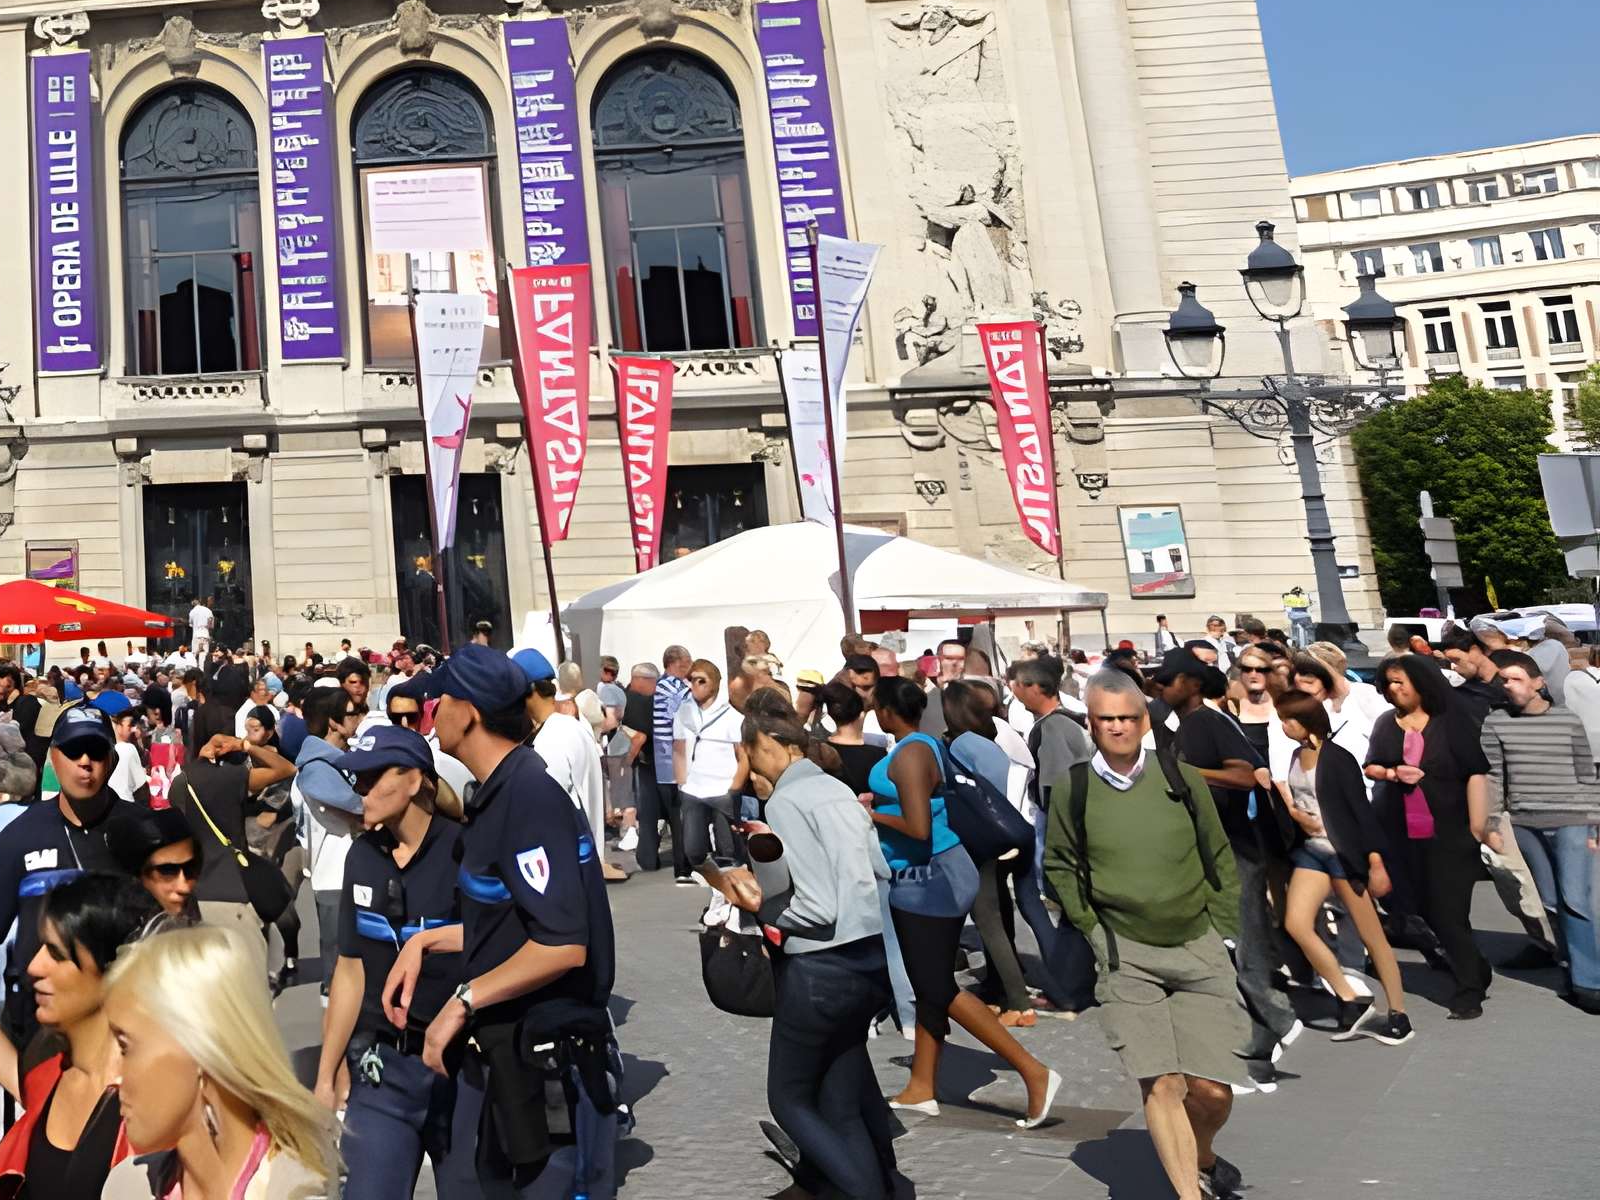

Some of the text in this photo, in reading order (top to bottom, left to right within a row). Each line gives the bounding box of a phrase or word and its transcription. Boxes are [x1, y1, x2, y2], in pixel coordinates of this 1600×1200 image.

[48, 129, 79, 195] LILLE
[50, 201, 80, 234] DE
[52, 240, 82, 328] OPERA
[626, 378, 660, 554] FANTASTI
